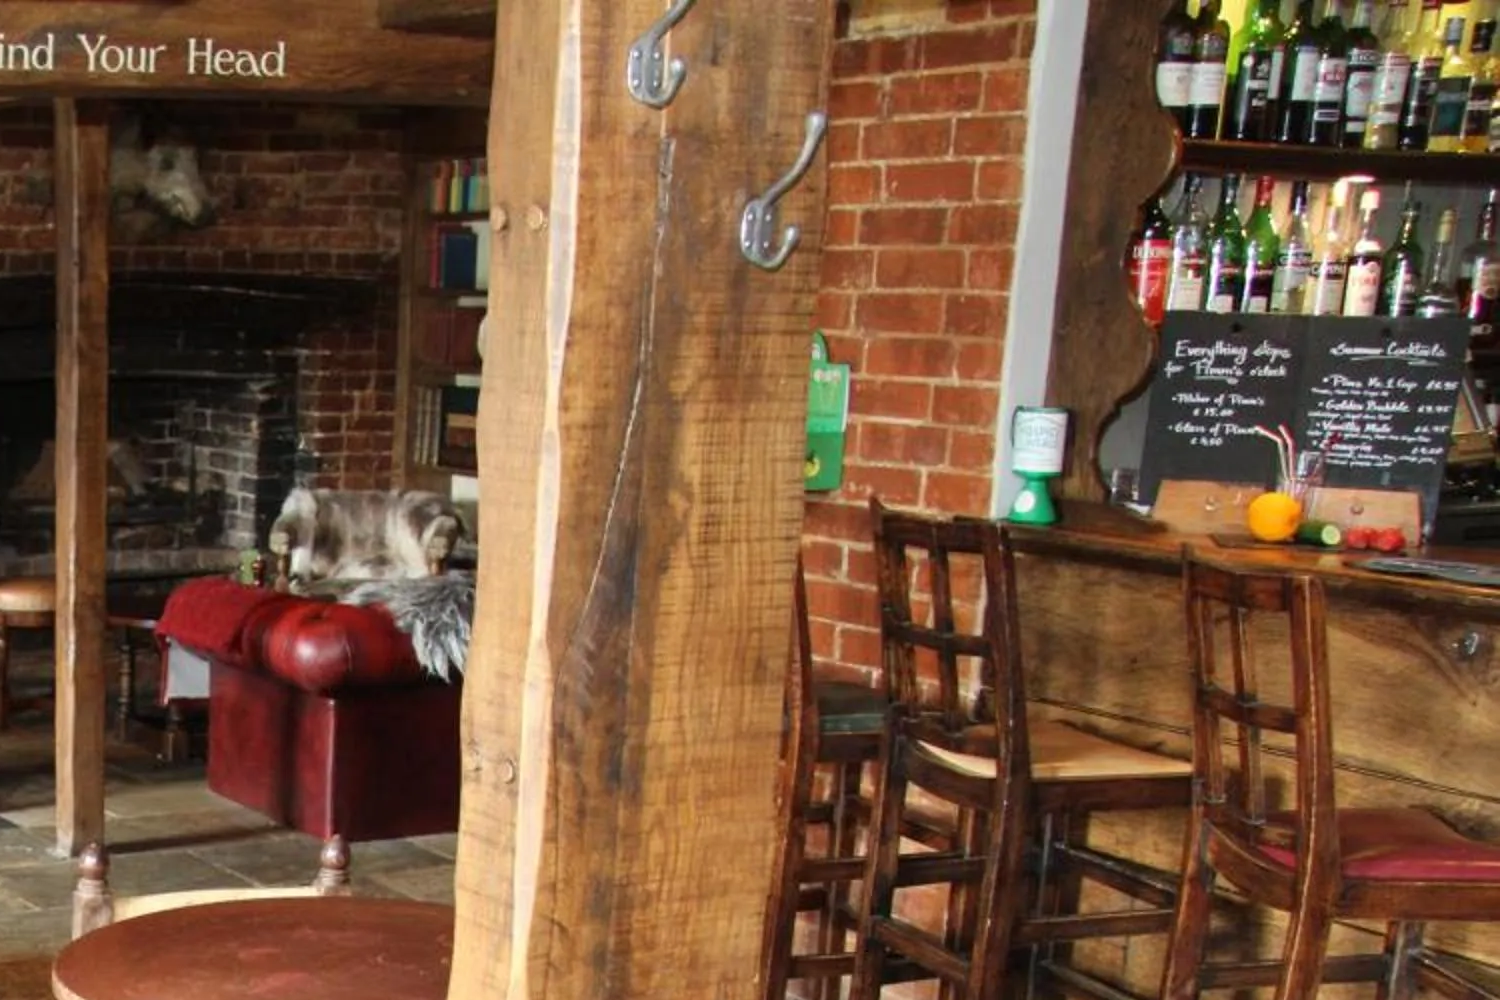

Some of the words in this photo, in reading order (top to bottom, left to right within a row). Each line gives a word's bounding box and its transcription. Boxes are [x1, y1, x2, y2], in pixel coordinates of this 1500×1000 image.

[77, 32, 167, 74] Your
[187, 37, 286, 77] Head
[1175, 339, 1248, 366] Everything
[1252, 340, 1292, 364] stops
[1387, 342, 1447, 357] Cocktails
[1164, 360, 1185, 379] for
[1190, 358, 1244, 377] Pimm's
[1214, 393, 1225, 407] of
[1325, 400, 1363, 411] Golden
[1174, 421, 1206, 433] Glass
[1209, 422, 1221, 436] of
